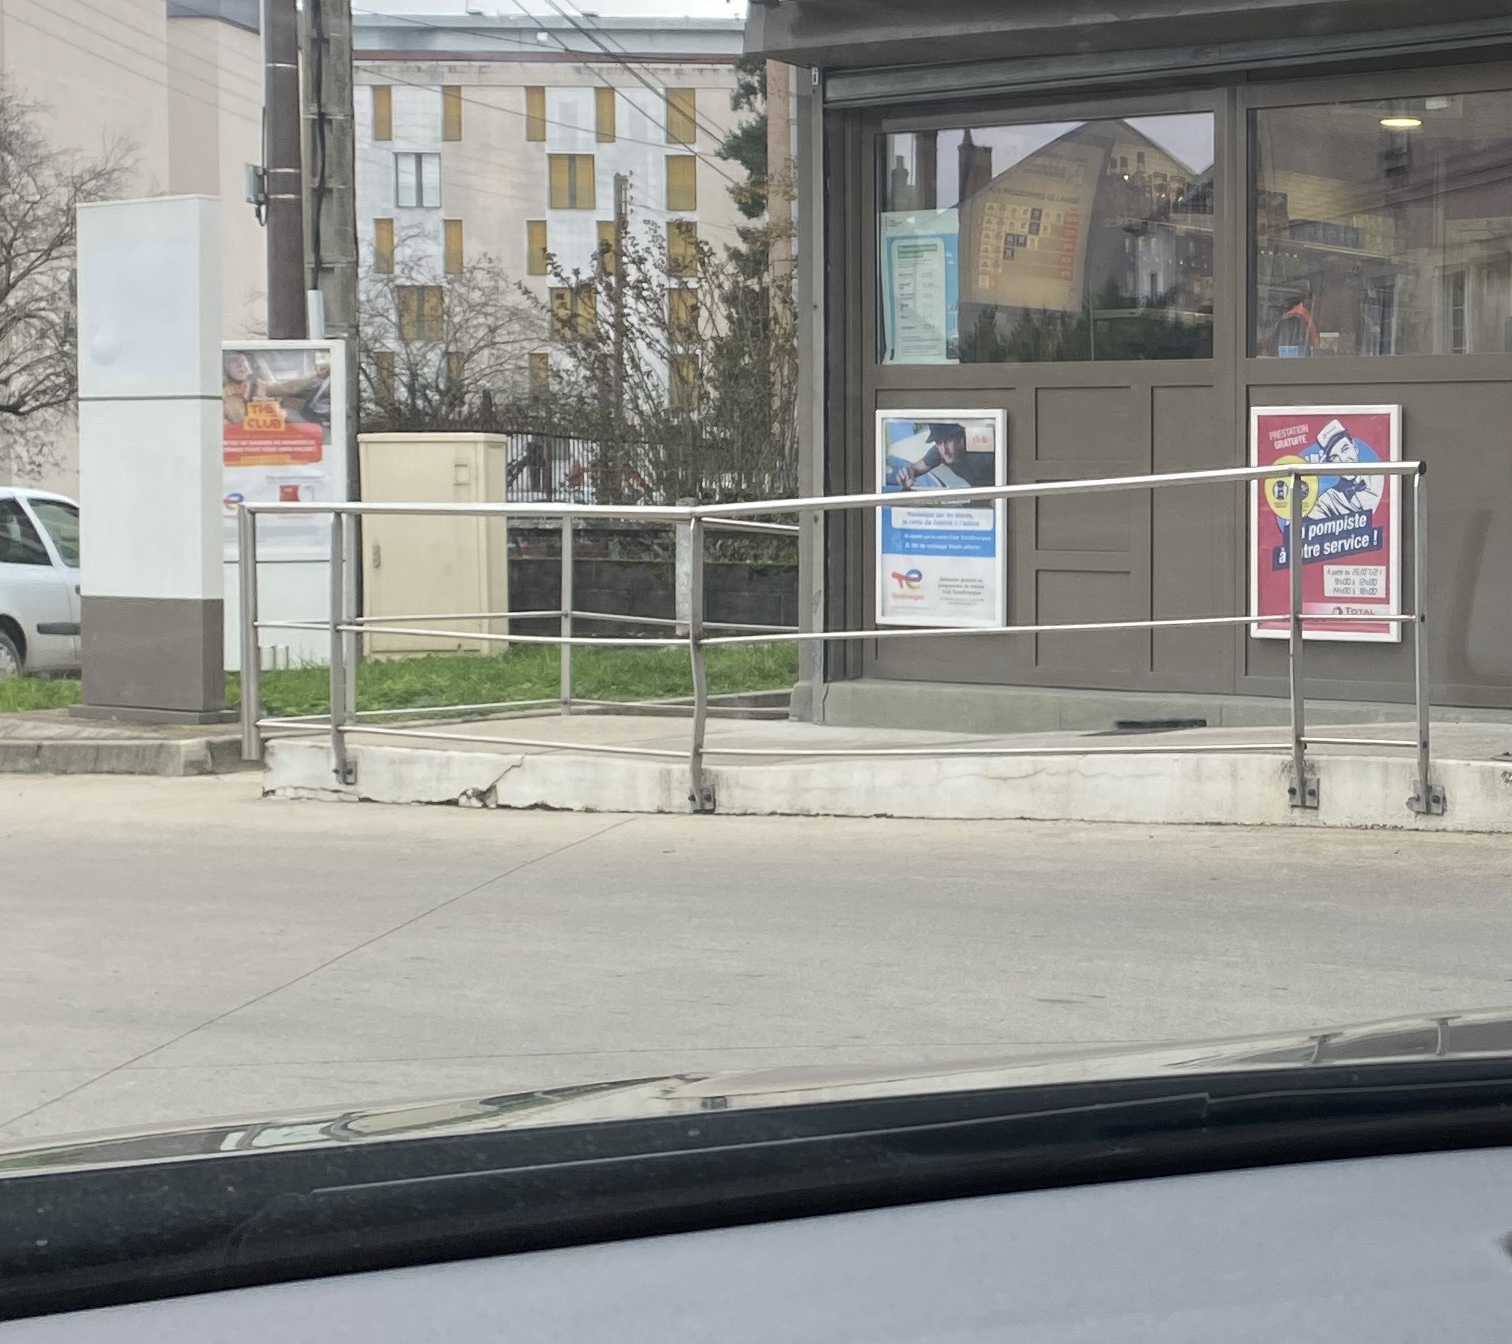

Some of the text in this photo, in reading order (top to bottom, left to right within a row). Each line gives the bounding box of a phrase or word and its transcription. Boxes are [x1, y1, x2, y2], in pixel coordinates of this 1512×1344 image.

[1268, 423, 1309, 441] PRESTATION
[1274, 434, 1308, 450] GRATUITE
[1308, 514, 1367, 541] pompiste
[1278, 547, 1287, 564] à
[1302, 543, 1320, 559] tre
[1323, 533, 1370, 555] service
[1372, 529, 1378, 546] !
